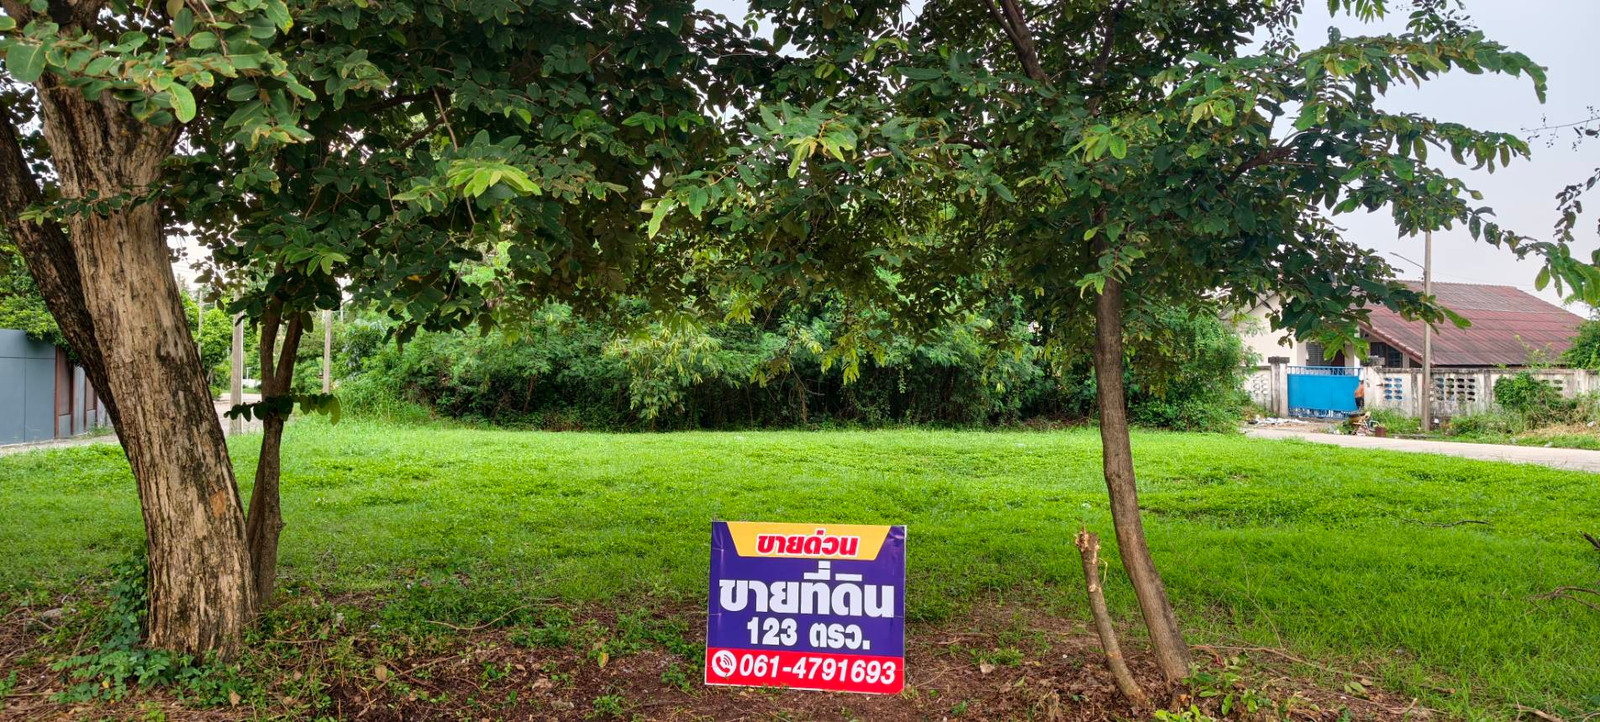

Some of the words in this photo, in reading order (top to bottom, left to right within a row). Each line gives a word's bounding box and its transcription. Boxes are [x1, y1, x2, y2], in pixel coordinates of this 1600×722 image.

[757, 529, 859, 556] ขายด่วน
[719, 560, 895, 618] ขายที่ดิน
[747, 617, 798, 646] 123
[809, 622, 871, 650] ตรว.
[739, 653, 896, 685] 061-4791693
